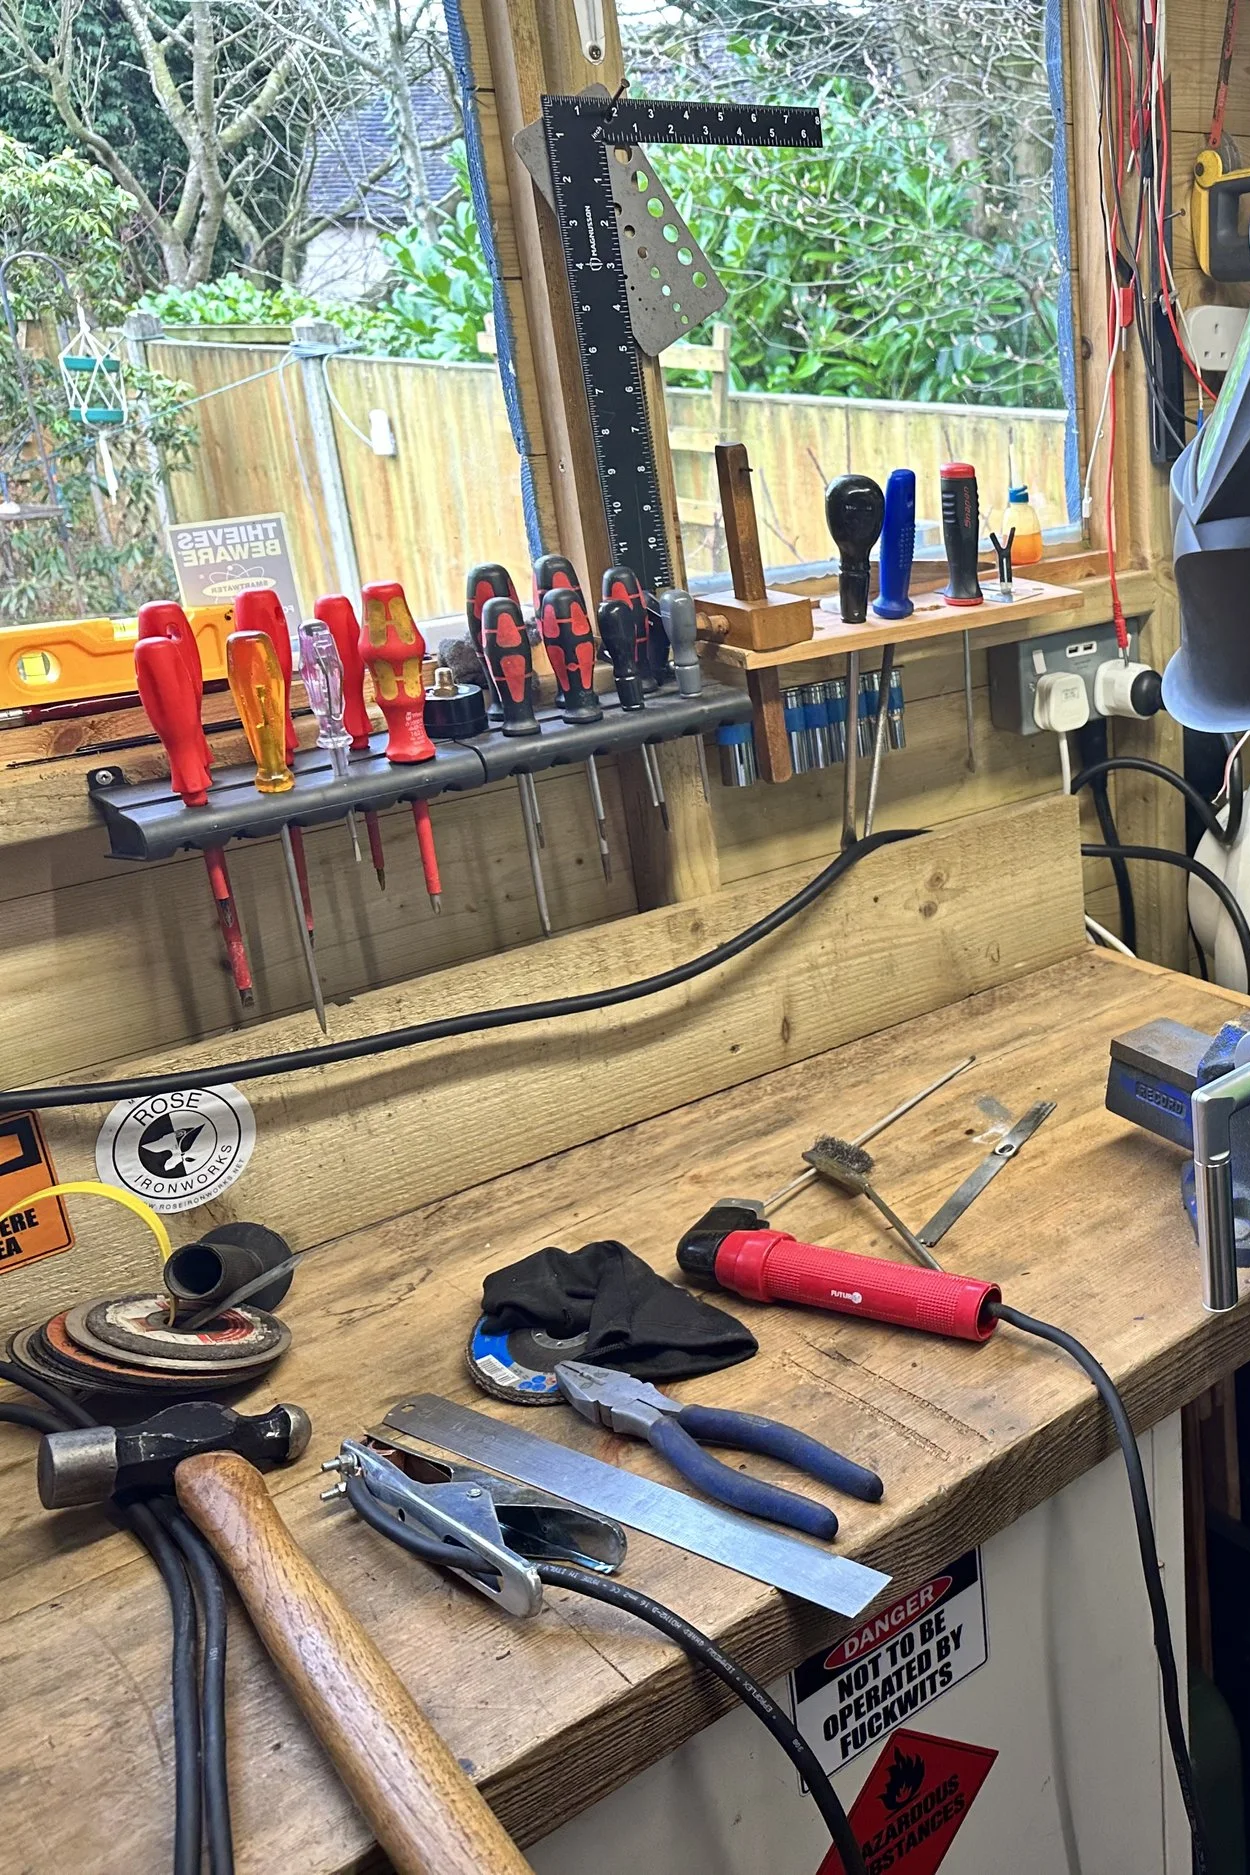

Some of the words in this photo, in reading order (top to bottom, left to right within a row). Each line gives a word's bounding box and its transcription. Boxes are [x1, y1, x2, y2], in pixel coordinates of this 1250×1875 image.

[574, 105, 580, 116] 1
[611, 107, 618, 117] 2
[648, 108, 654, 118] 3
[683, 110, 690, 119] 4
[718, 112, 724, 121] 5
[750, 113, 757, 122] 6
[783, 115, 789, 124] 7
[814, 116, 820, 125] 8
[632, 123, 638, 132] 1
[668, 124, 674, 134] 2
[703, 126, 709, 135] 3
[736, 127, 742, 136] 4
[769, 128, 775, 137] 5
[801, 129, 807, 138] 6
[584, 206, 598, 256] MAGNUSSON
[612, 502, 622, 514] 10
[619, 542, 628, 553] 11
[648, 537, 657, 549] 10
[654, 576, 663, 587] 11
[133, 1092, 202, 1126] ROSE
[1138, 1085, 1184, 1115] RECORD
[134, 1144, 232, 1194] IRONWORKS
[842, 1583, 935, 1661] DANGER
[836, 1654, 886, 1704] NOT
[888, 1632, 916, 1666] TO
[919, 1608, 947, 1639] BE
[742, 1680, 773, 1713] EPROFLEX
[822, 1643, 932, 1742] OPERATED
[937, 1623, 963, 1659] BY
[839, 1661, 953, 1761] FUCKWITS
[862, 1774, 960, 1858] AZARDOUS
[868, 1792, 966, 1875] BSTANCES
